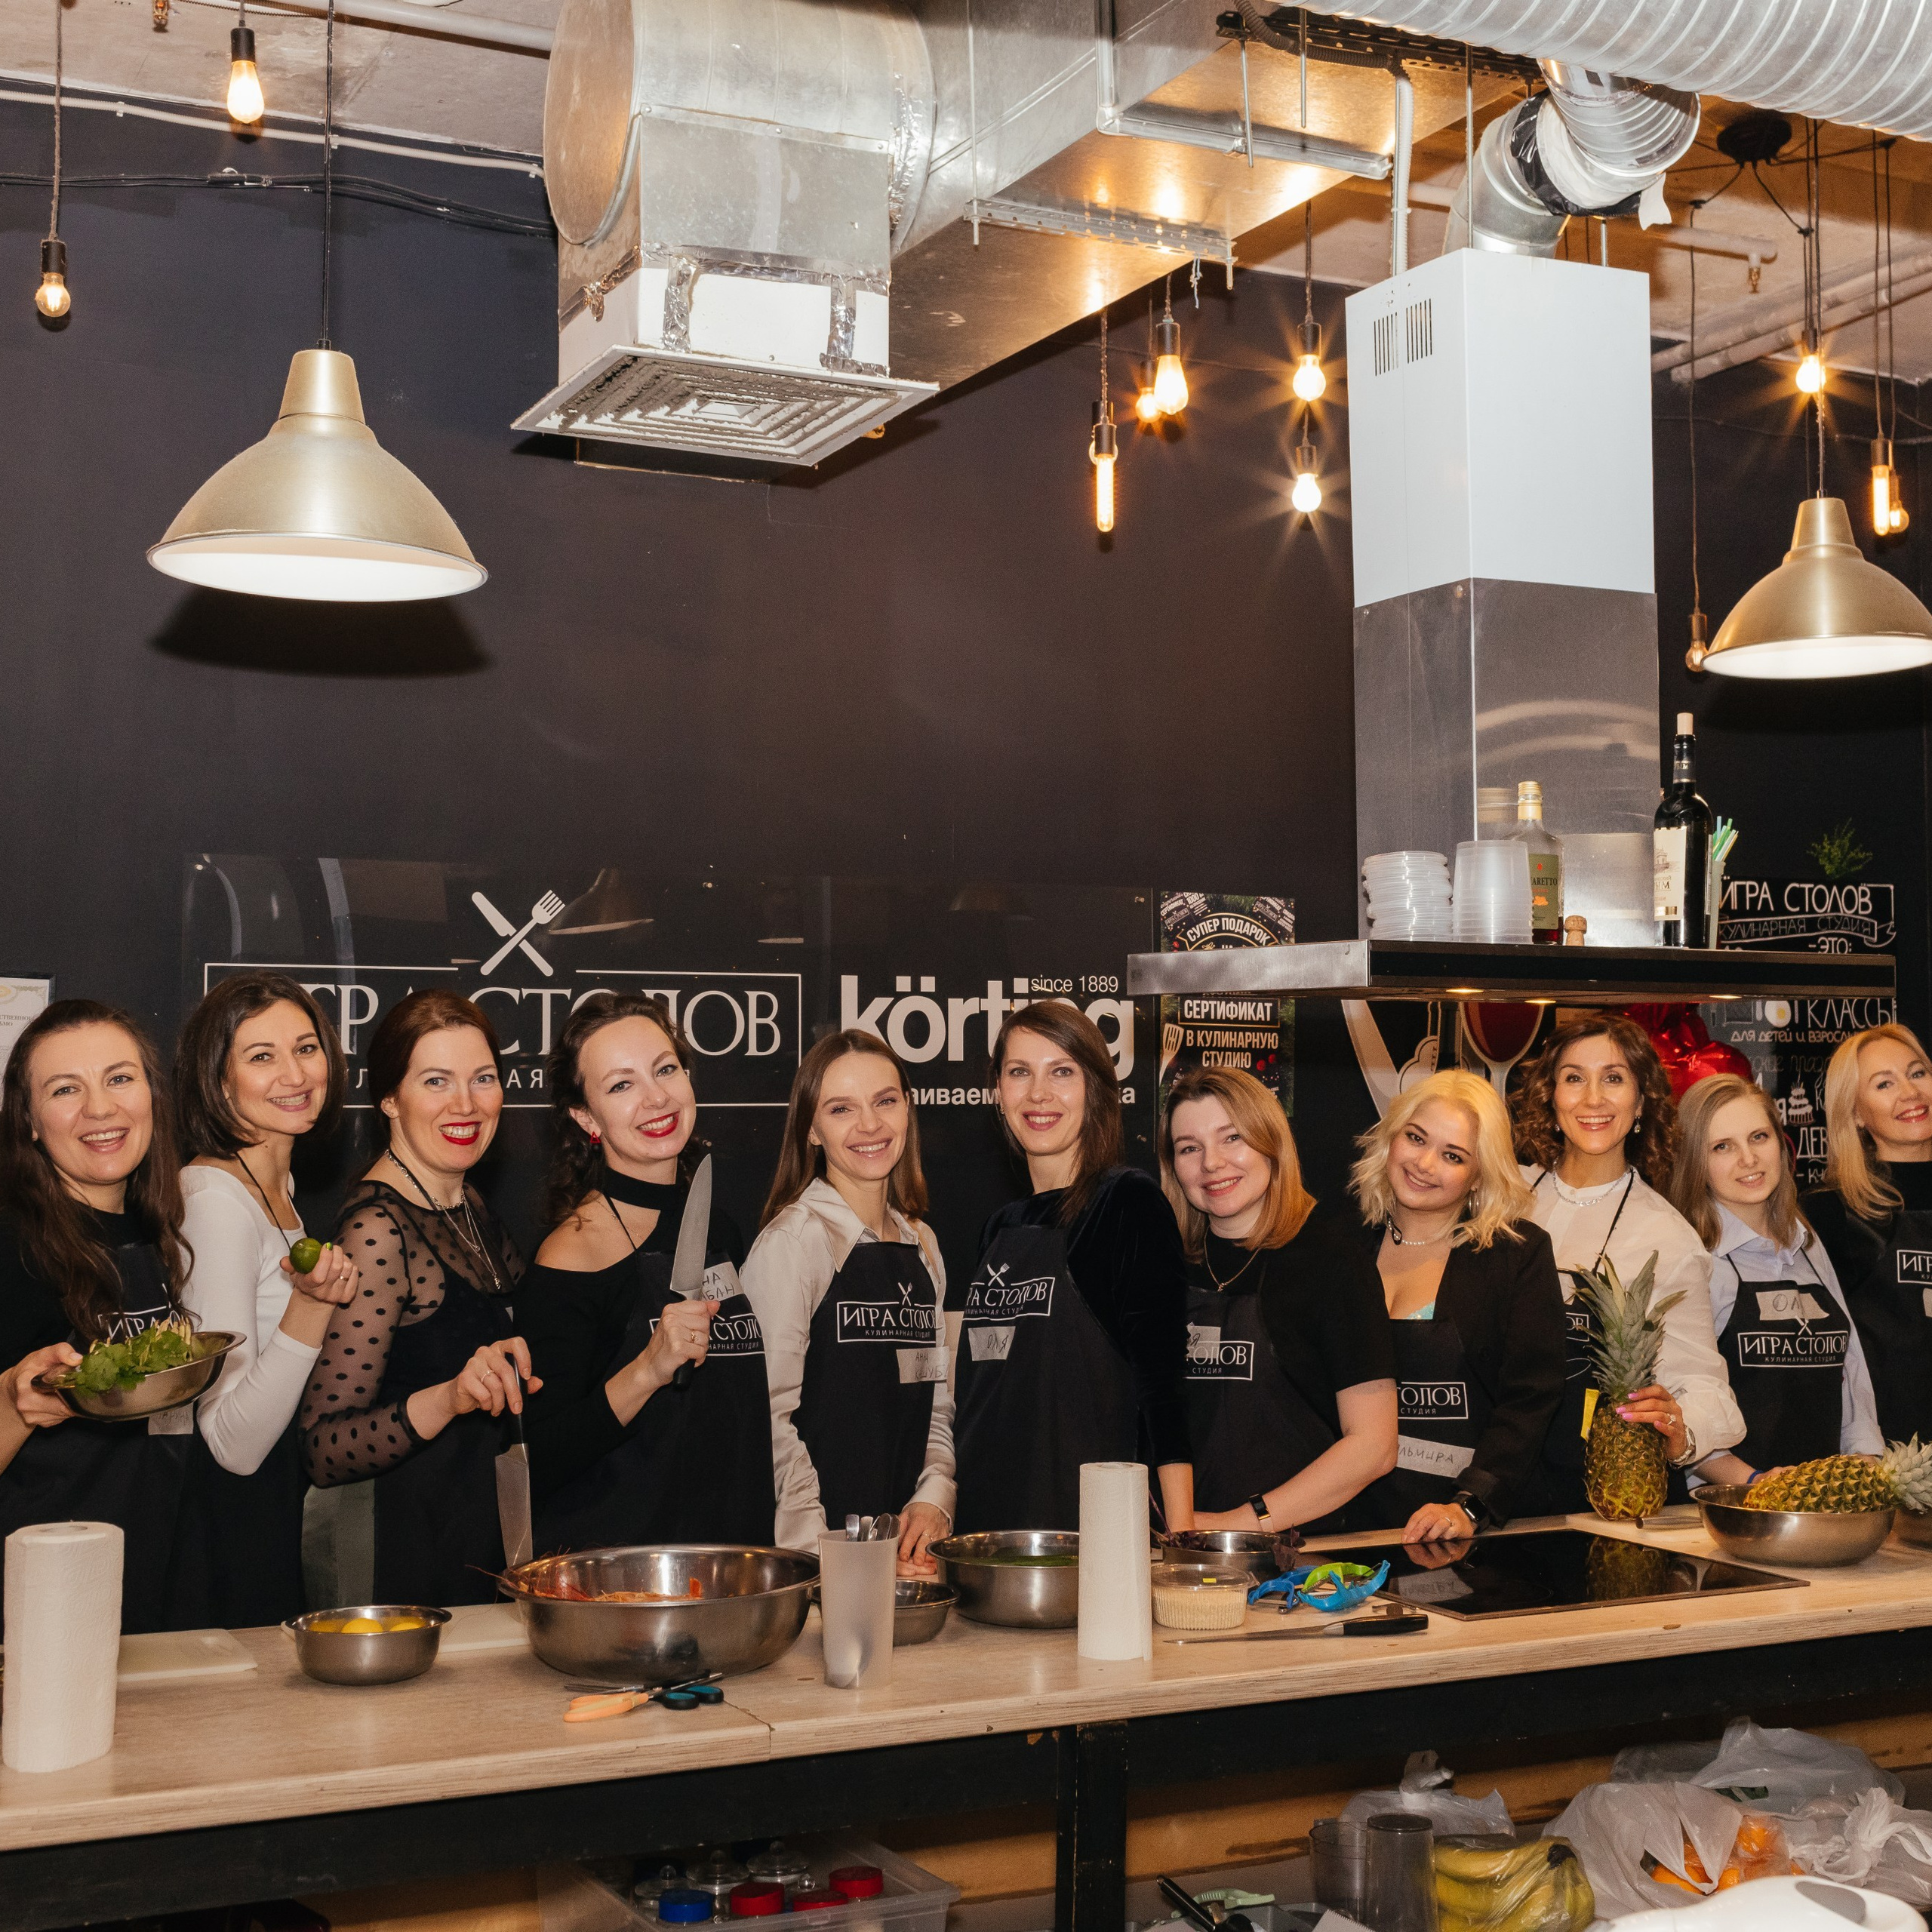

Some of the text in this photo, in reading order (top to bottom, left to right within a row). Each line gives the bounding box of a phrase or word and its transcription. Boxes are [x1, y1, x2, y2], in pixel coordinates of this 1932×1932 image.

[1719, 881, 1872, 915] ИГРА СТОЛОВ
[1186, 918, 1220, 942] СУПЕР
[1222, 918, 1271, 946] ПОДАРОК
[1719, 916, 1871, 940] КУЛИНАРНАЯ СТУДИЯ
[1031, 975, 1118, 992] since 1889
[1184, 999, 1272, 1021] СЕРТИФИКАТ
[1186, 1030, 1278, 1050] В КУЛИНАРНУЮ
[1202, 1051, 1251, 1069] СТУДИЮ
[985, 1281, 1047, 1306] СТОЛОВ
[843, 1306, 896, 1327] ИГРА
[737, 1342, 759, 1350] СТУДИЯ
[988, 1333, 1009, 1353] ОЛЯ
[1744, 1335, 1847, 1355] ИГРА СТОЛОВ
[1399, 1446, 1454, 1464] ЛЬМИРА
